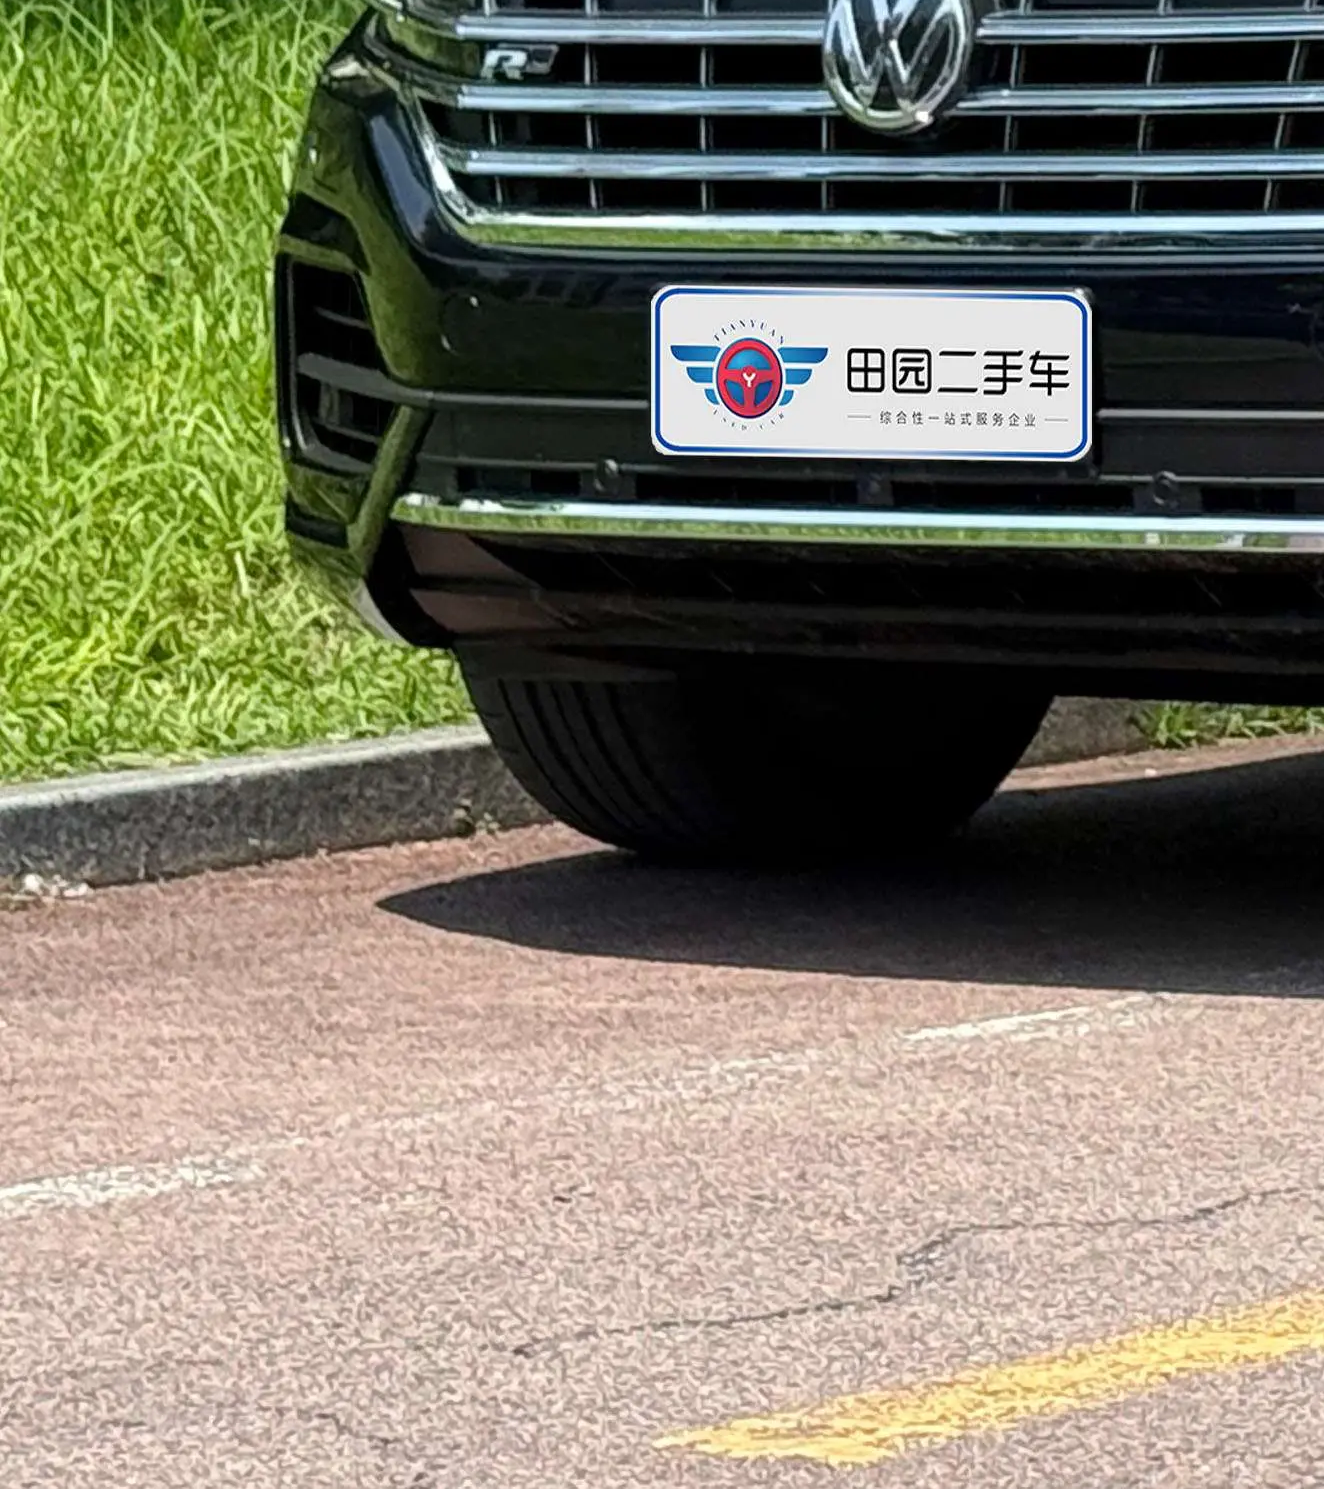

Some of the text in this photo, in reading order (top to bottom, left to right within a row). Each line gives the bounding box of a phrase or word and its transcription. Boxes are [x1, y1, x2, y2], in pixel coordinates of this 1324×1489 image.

[847, 347, 1070, 396] 田园二手车
[879, 410, 1036, 428] 综合性一站式服务企业
